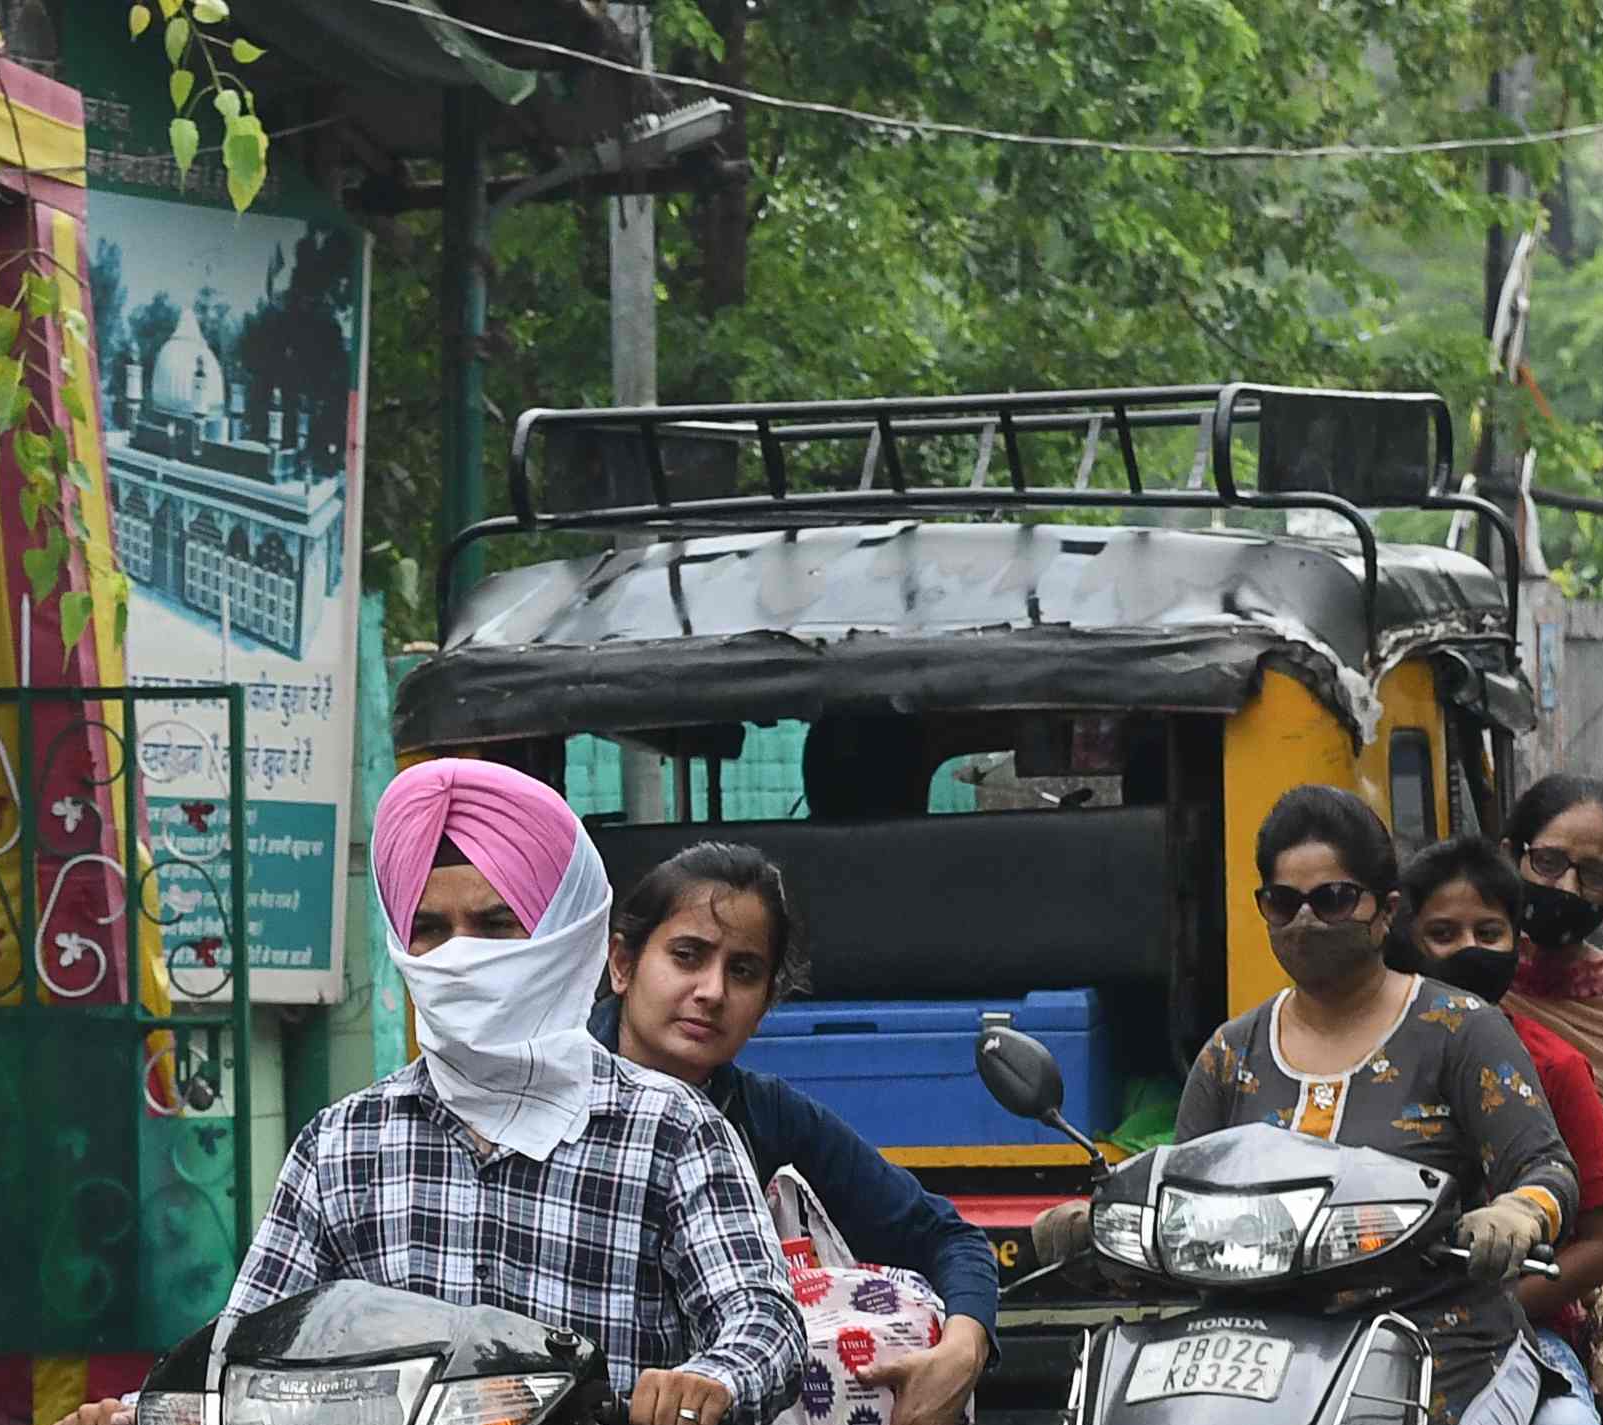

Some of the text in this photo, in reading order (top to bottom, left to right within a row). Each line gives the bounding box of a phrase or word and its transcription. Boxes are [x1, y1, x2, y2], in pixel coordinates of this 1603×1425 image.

[1186, 1316, 1268, 1332] HONDA
[1173, 1336, 1274, 1367] PB02C
[1163, 1363, 1264, 1392] K8322
